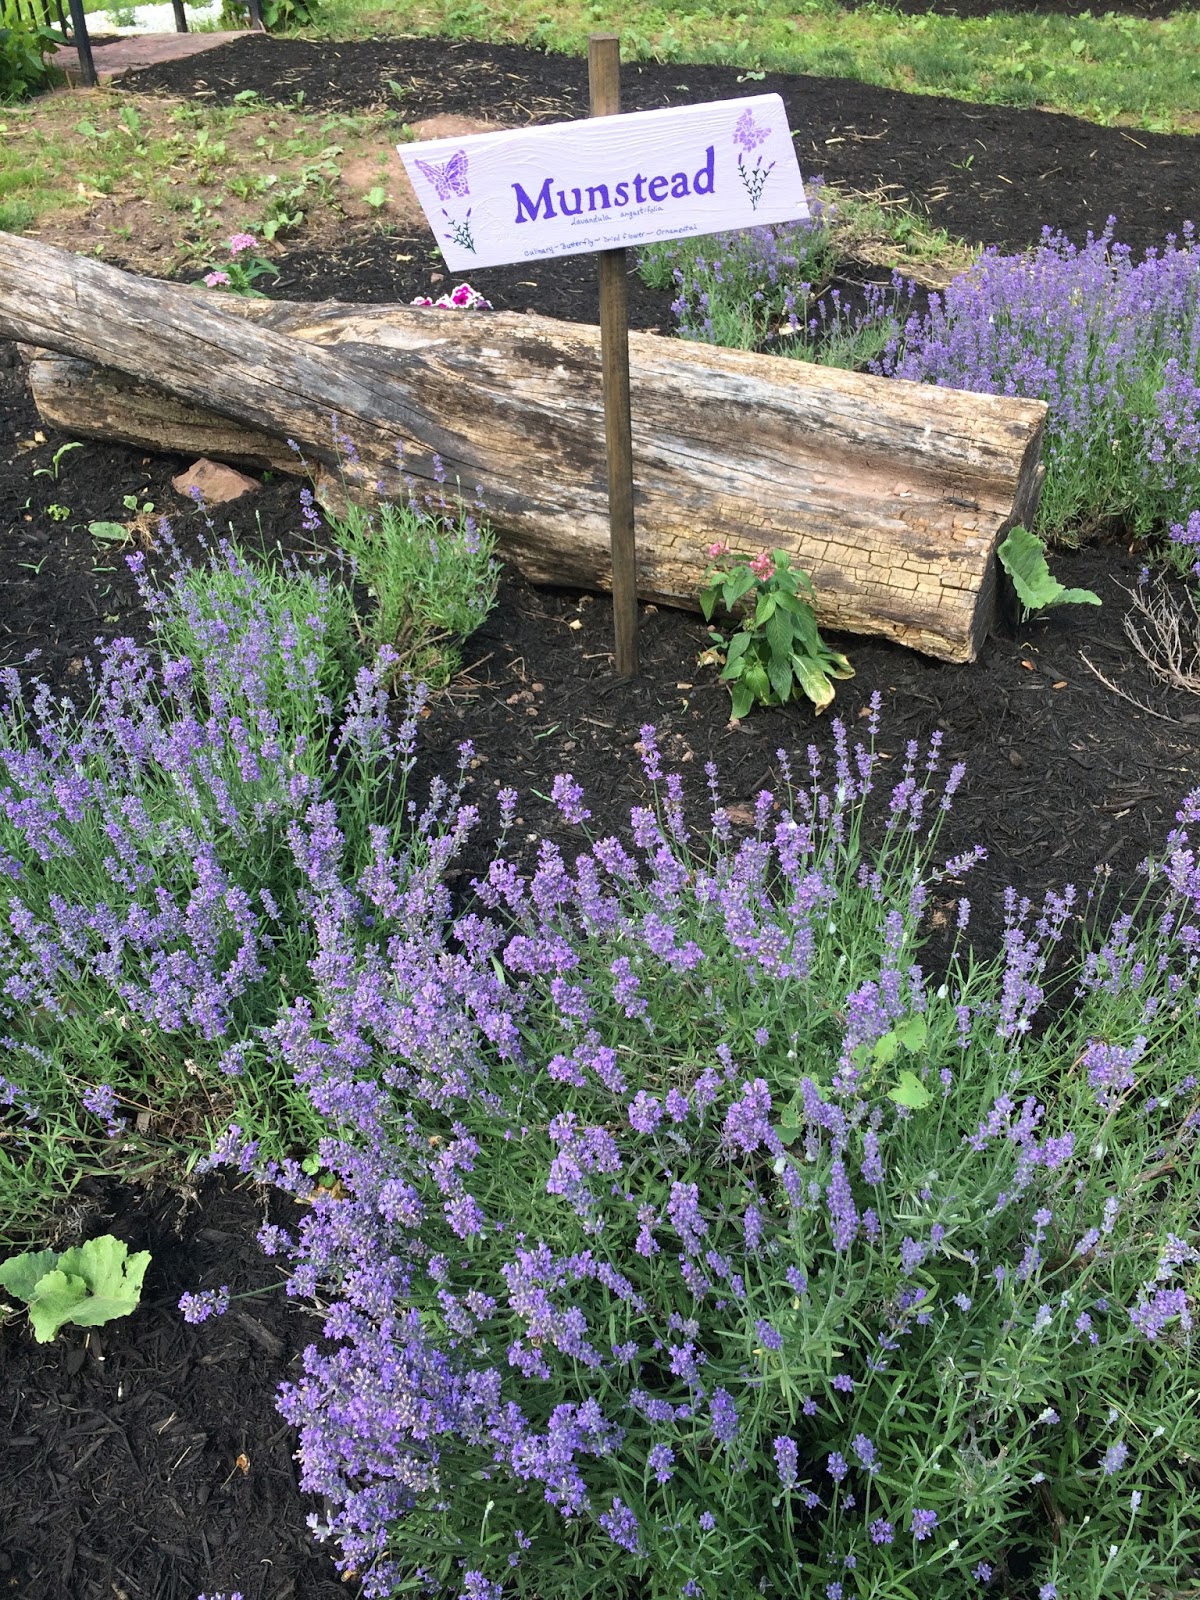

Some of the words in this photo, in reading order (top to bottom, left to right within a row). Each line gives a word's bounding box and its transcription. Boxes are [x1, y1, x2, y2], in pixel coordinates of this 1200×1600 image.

[511, 145, 716, 224] Munstead
[570, 213, 612, 226] Lavandula
[619, 205, 664, 220] angustifolia
[523, 245, 555, 257] Culinary
[559, 237, 594, 250] Butterfly
[603, 234, 621, 243] Dried
[655, 223, 698, 236] Ornamental
